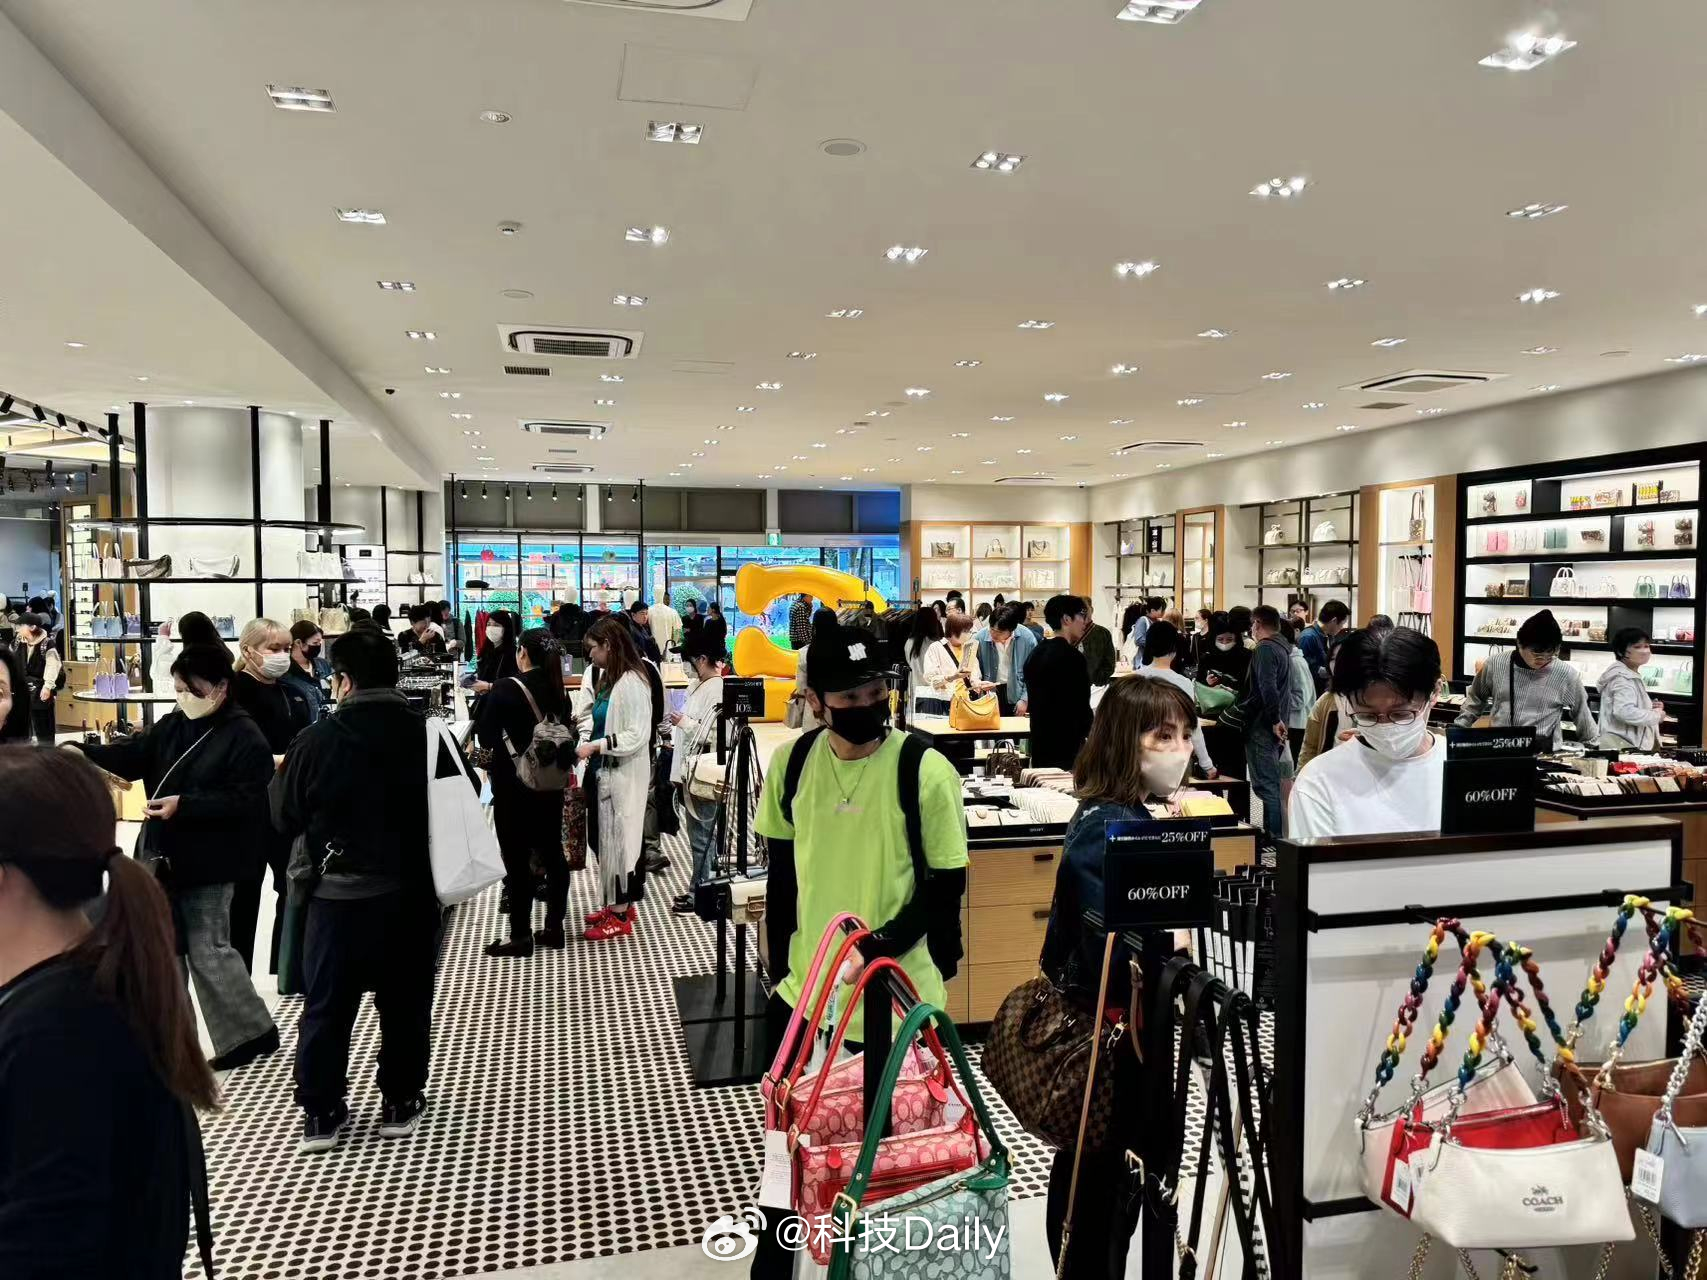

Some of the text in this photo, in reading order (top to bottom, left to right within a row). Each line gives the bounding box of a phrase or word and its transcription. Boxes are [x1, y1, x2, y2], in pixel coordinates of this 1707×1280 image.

[1492, 737, 1533, 749] 25%OFF
[1465, 787, 1518, 803] 60%OFF
[1161, 831, 1208, 843] 25%OFF
[1127, 884, 1190, 901] 60%OFF
[1522, 1196, 1564, 1206] COACH
